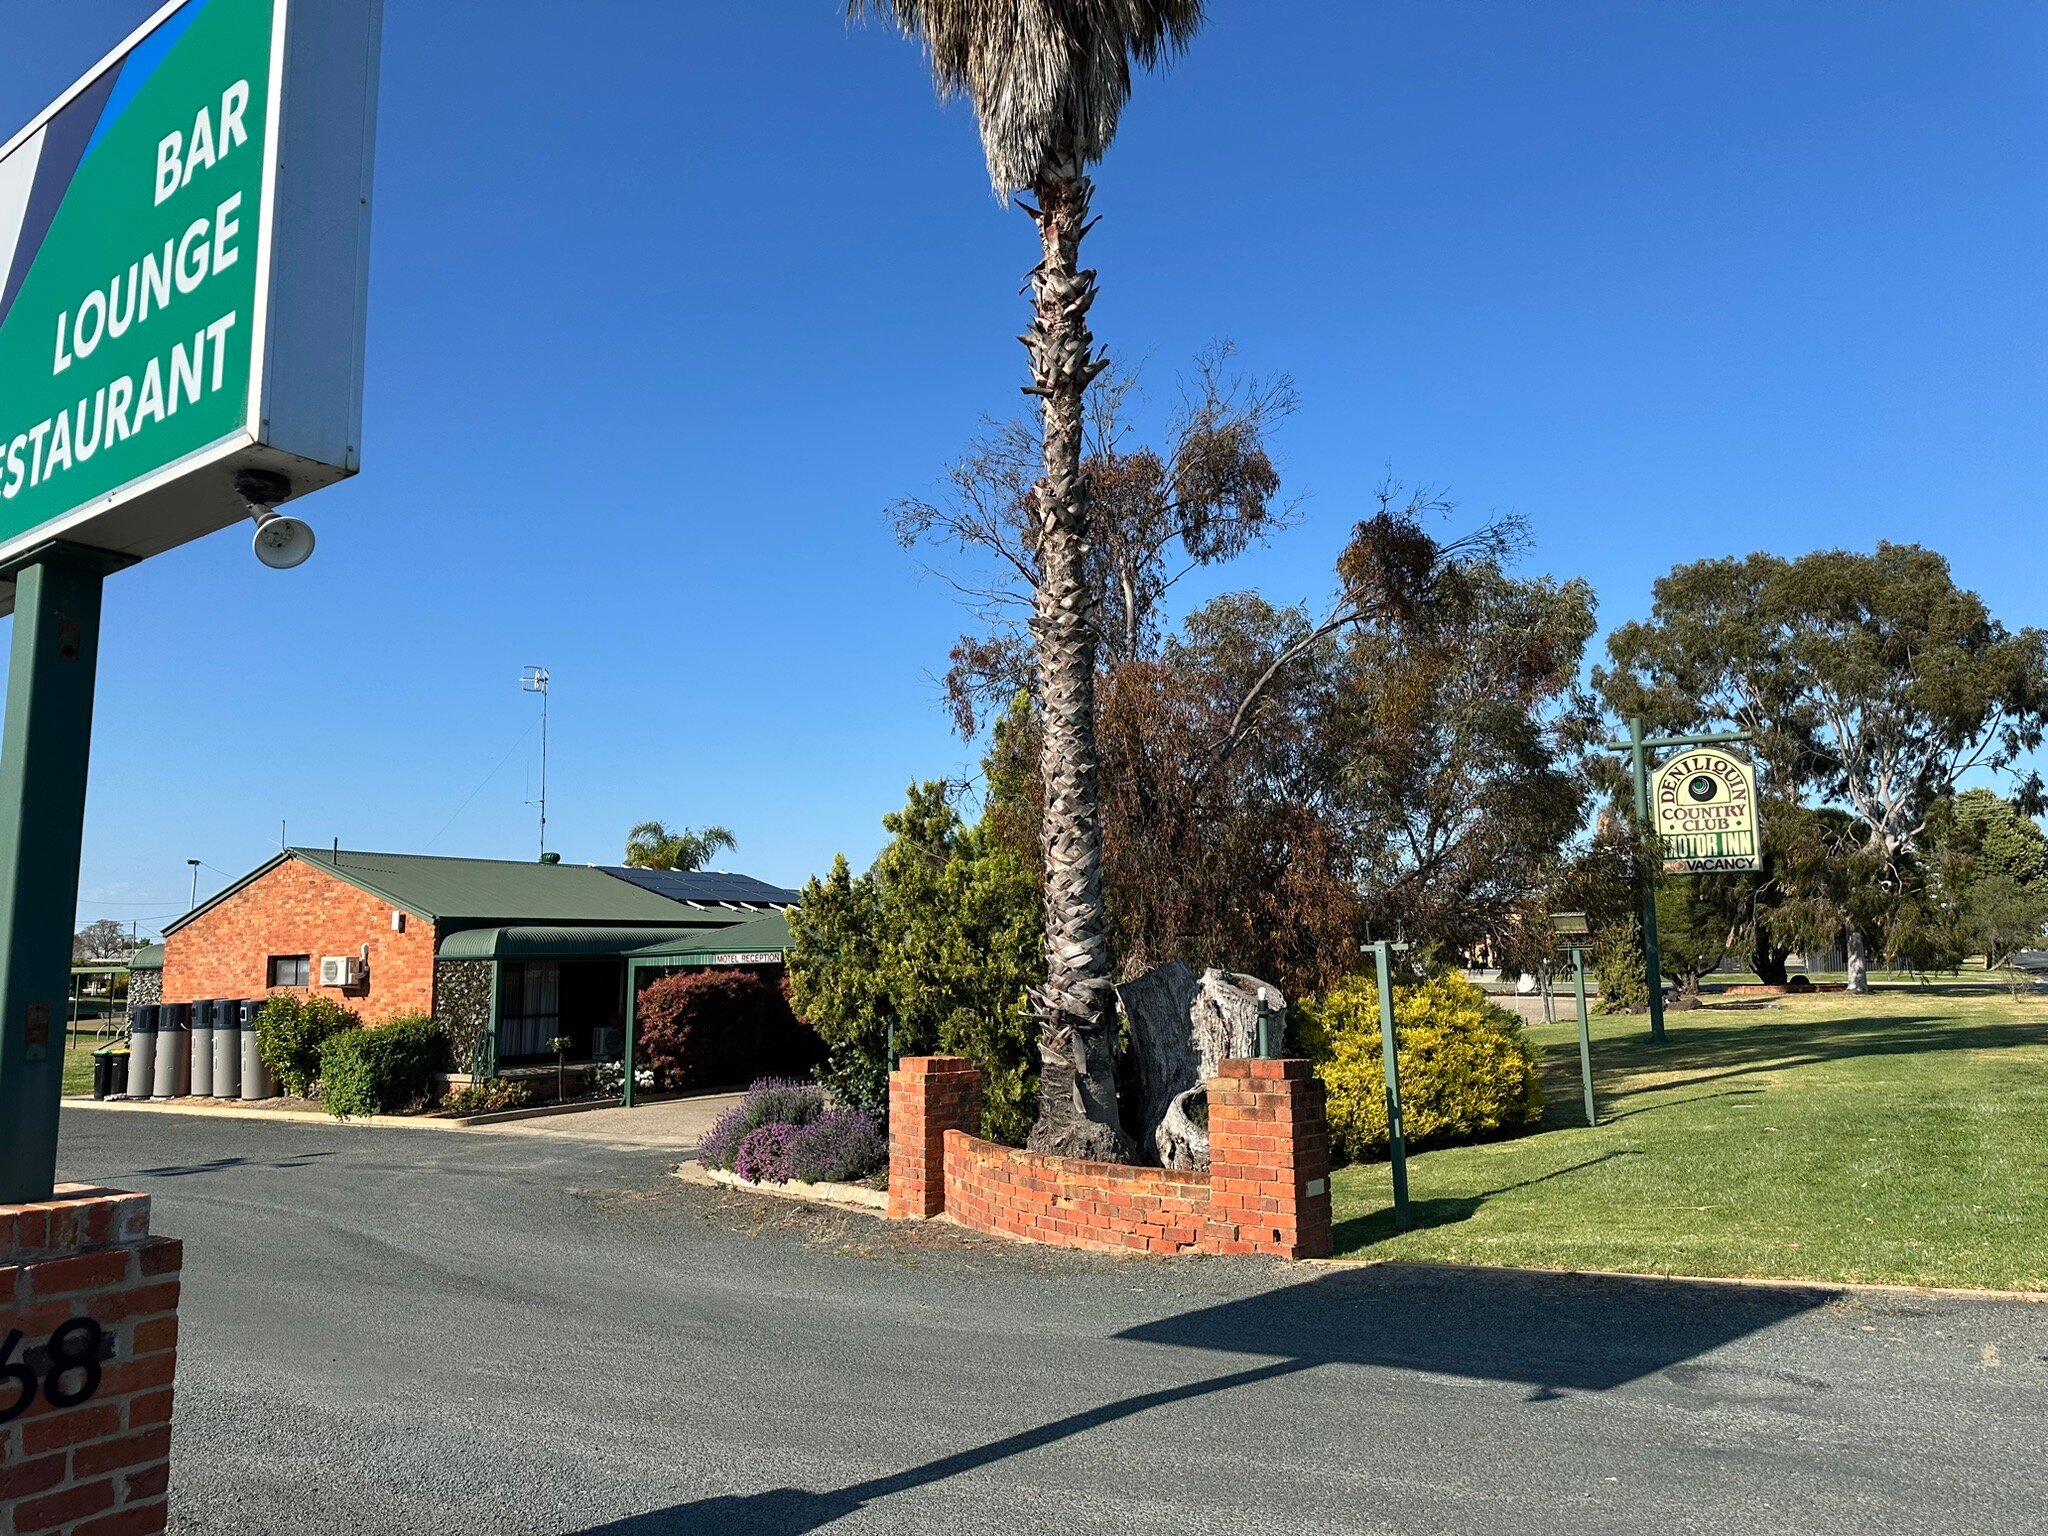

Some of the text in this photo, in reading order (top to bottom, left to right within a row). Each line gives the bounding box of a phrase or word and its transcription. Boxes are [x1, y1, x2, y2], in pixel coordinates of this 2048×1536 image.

[155, 79, 249, 206] BAR
[53, 190, 242, 376] LOUNGE
[1661, 757, 1746, 804] DENILIQUIN
[1662, 804, 1746, 820] COUNTRY
[1682, 818, 1730, 831] CLUB
[1663, 831, 1752, 858] MOTOR INN
[1686, 858, 1755, 871] VACANCY
[717, 953, 779, 963] MOTEL RECEPTION
